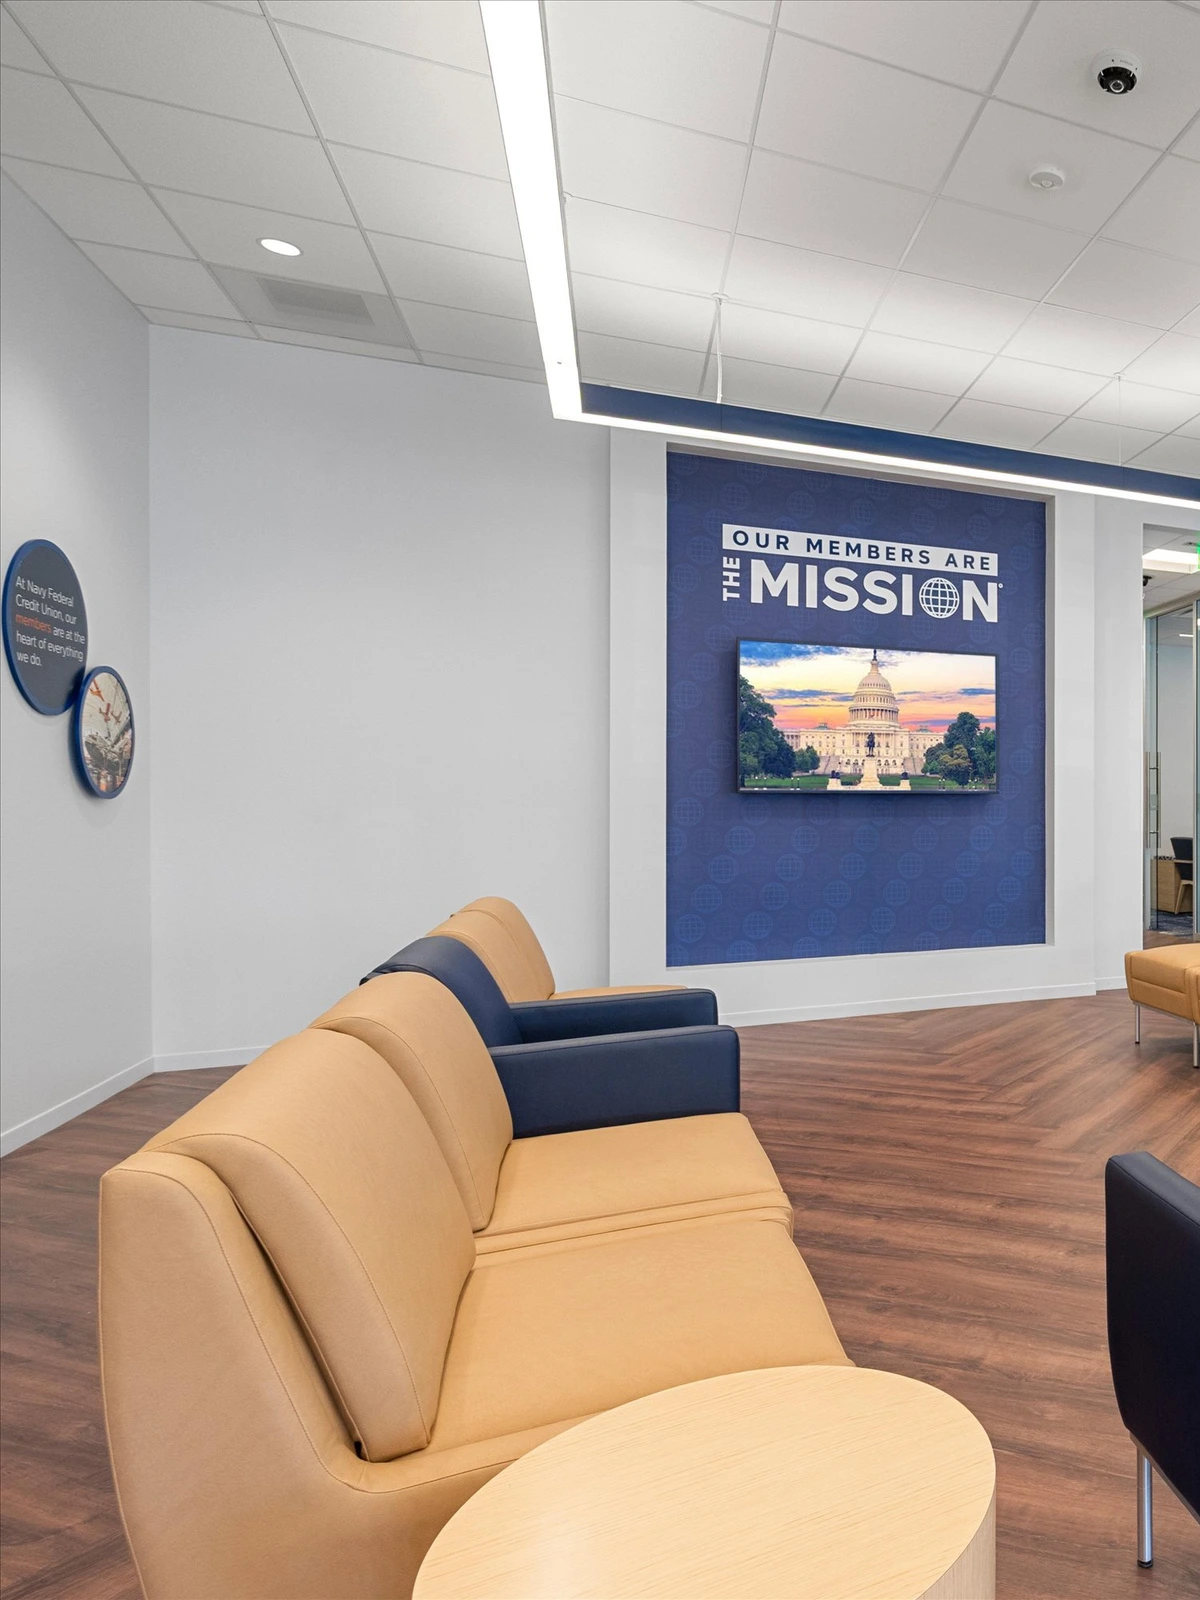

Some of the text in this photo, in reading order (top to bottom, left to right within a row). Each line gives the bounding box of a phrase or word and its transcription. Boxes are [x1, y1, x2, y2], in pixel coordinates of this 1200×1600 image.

[732, 530, 991, 571] OUR MEMBERS ARE
[15, 575, 75, 607] At Navy Federal
[722, 556, 740, 602] THE
[15, 594, 78, 625] Credit Union, our
[15, 614, 86, 645] members are at the
[16, 630, 84, 662] heart of everything
[16, 651, 43, 666] we do.
